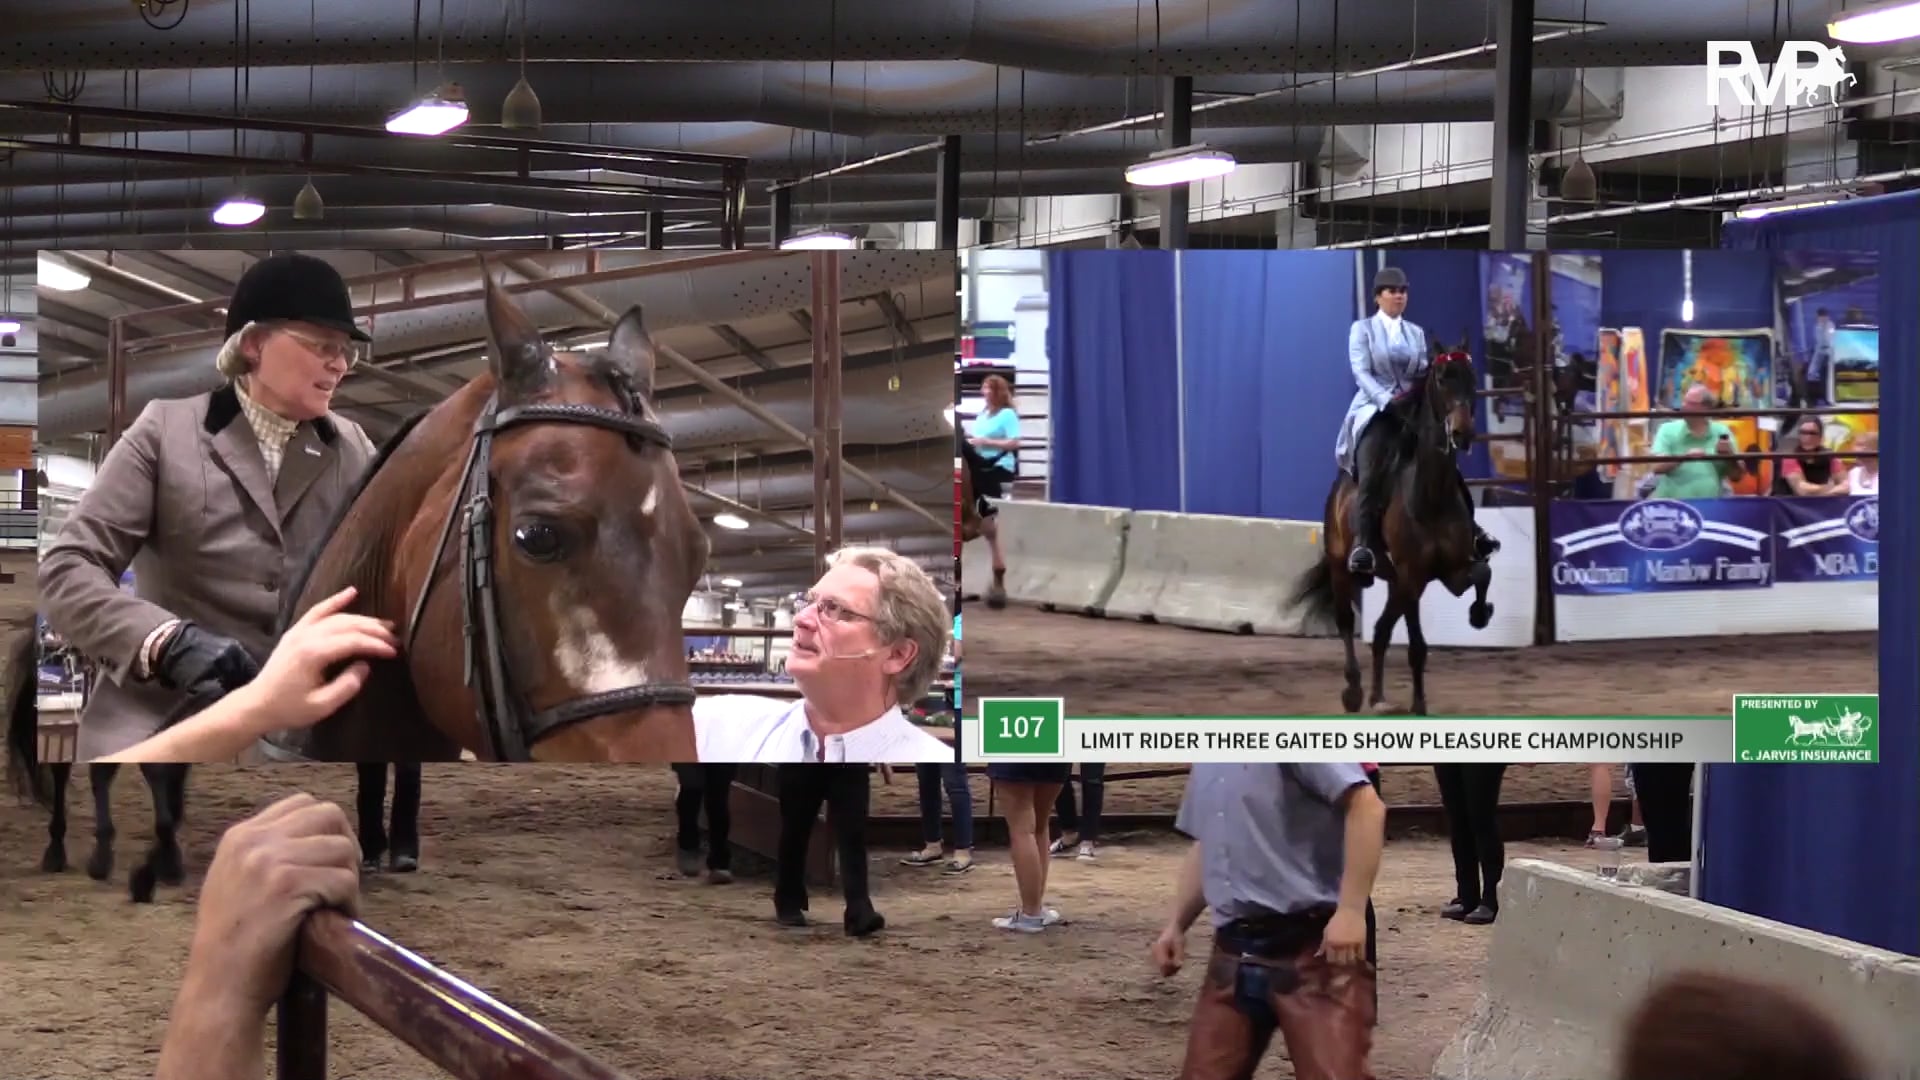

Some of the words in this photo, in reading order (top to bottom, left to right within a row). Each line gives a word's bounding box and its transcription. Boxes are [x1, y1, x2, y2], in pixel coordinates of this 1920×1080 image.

[1552, 561, 1629, 585] Goodman
[1645, 558, 1712, 583] Manilow
[1715, 556, 1771, 585] Family
[1814, 552, 1859, 576] MBA
